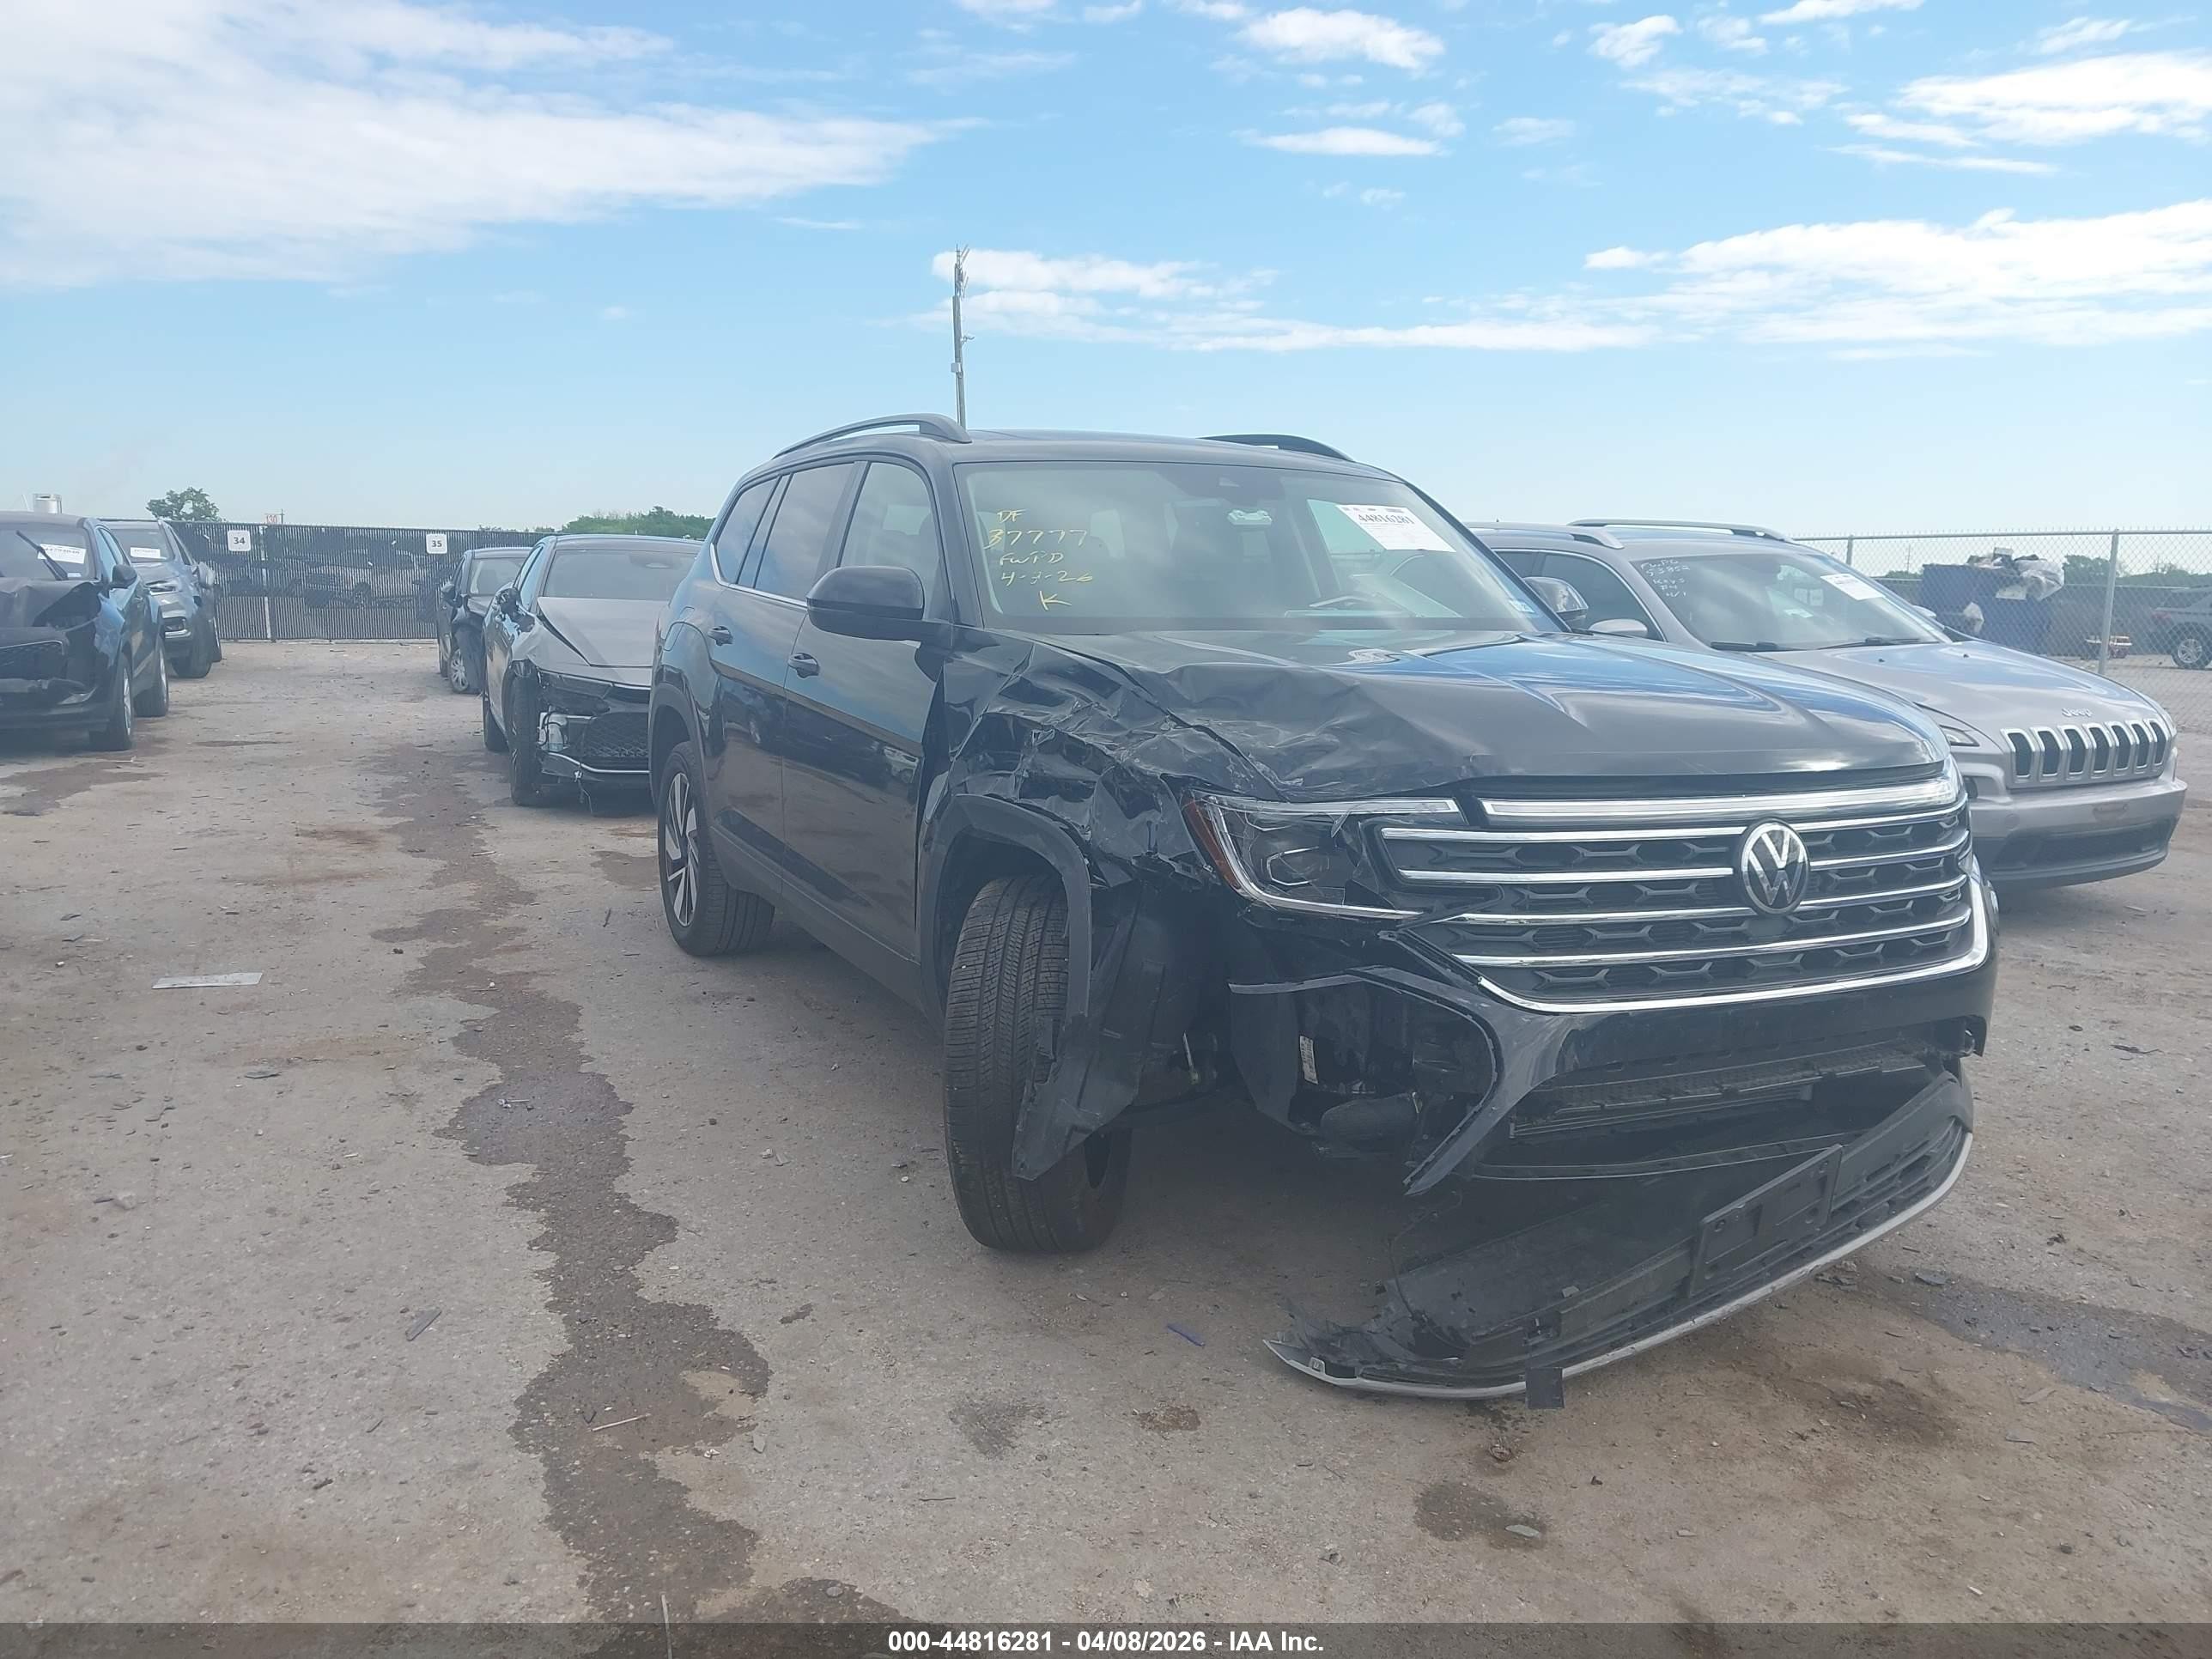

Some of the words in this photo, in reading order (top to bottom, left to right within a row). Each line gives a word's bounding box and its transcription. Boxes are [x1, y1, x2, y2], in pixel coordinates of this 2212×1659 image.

[1358, 514, 1416, 526] 44816281
[233, 537, 246, 545] 34
[982, 528, 1088, 550] 37777
[1038, 590, 1073, 611] K
[2061, 708, 2092, 718] Jeep
